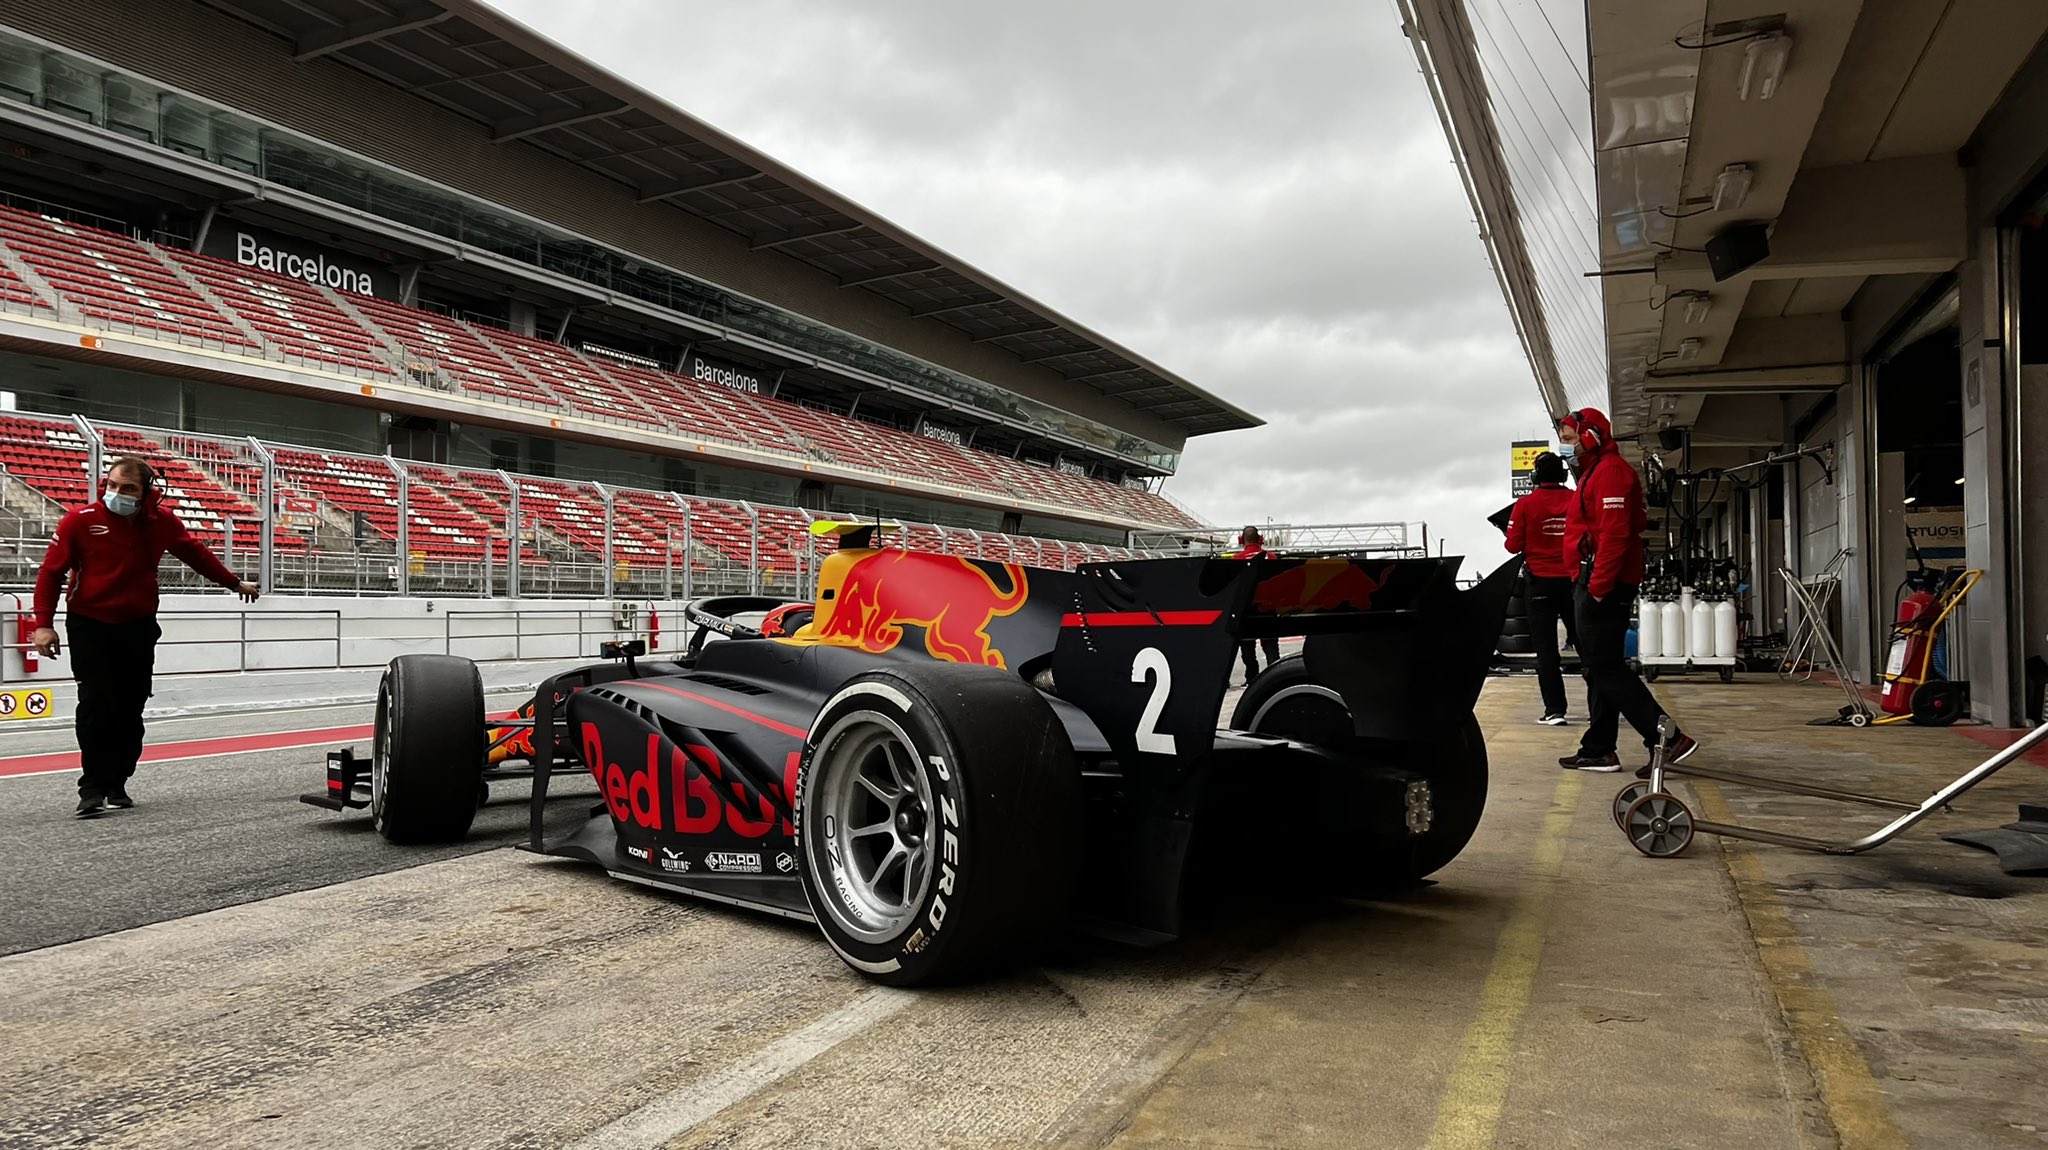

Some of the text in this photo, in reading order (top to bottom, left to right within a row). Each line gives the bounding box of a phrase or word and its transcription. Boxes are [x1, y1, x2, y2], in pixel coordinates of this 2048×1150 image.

[237, 231, 374, 297] Barcelona
[95, 339, 102, 349] 8
[695, 357, 759, 394] Barcelona
[923, 420, 961, 445] Barcelona
[1907, 525, 1965, 537] RTUOSI
[1131, 646, 1177, 755] 2
[581, 721, 662, 830] Red
[627, 845, 649, 860] KONI
[718, 853, 761, 866] NARDI
[928, 755, 960, 932] P ZERO
[835, 876, 864, 919] RACING
